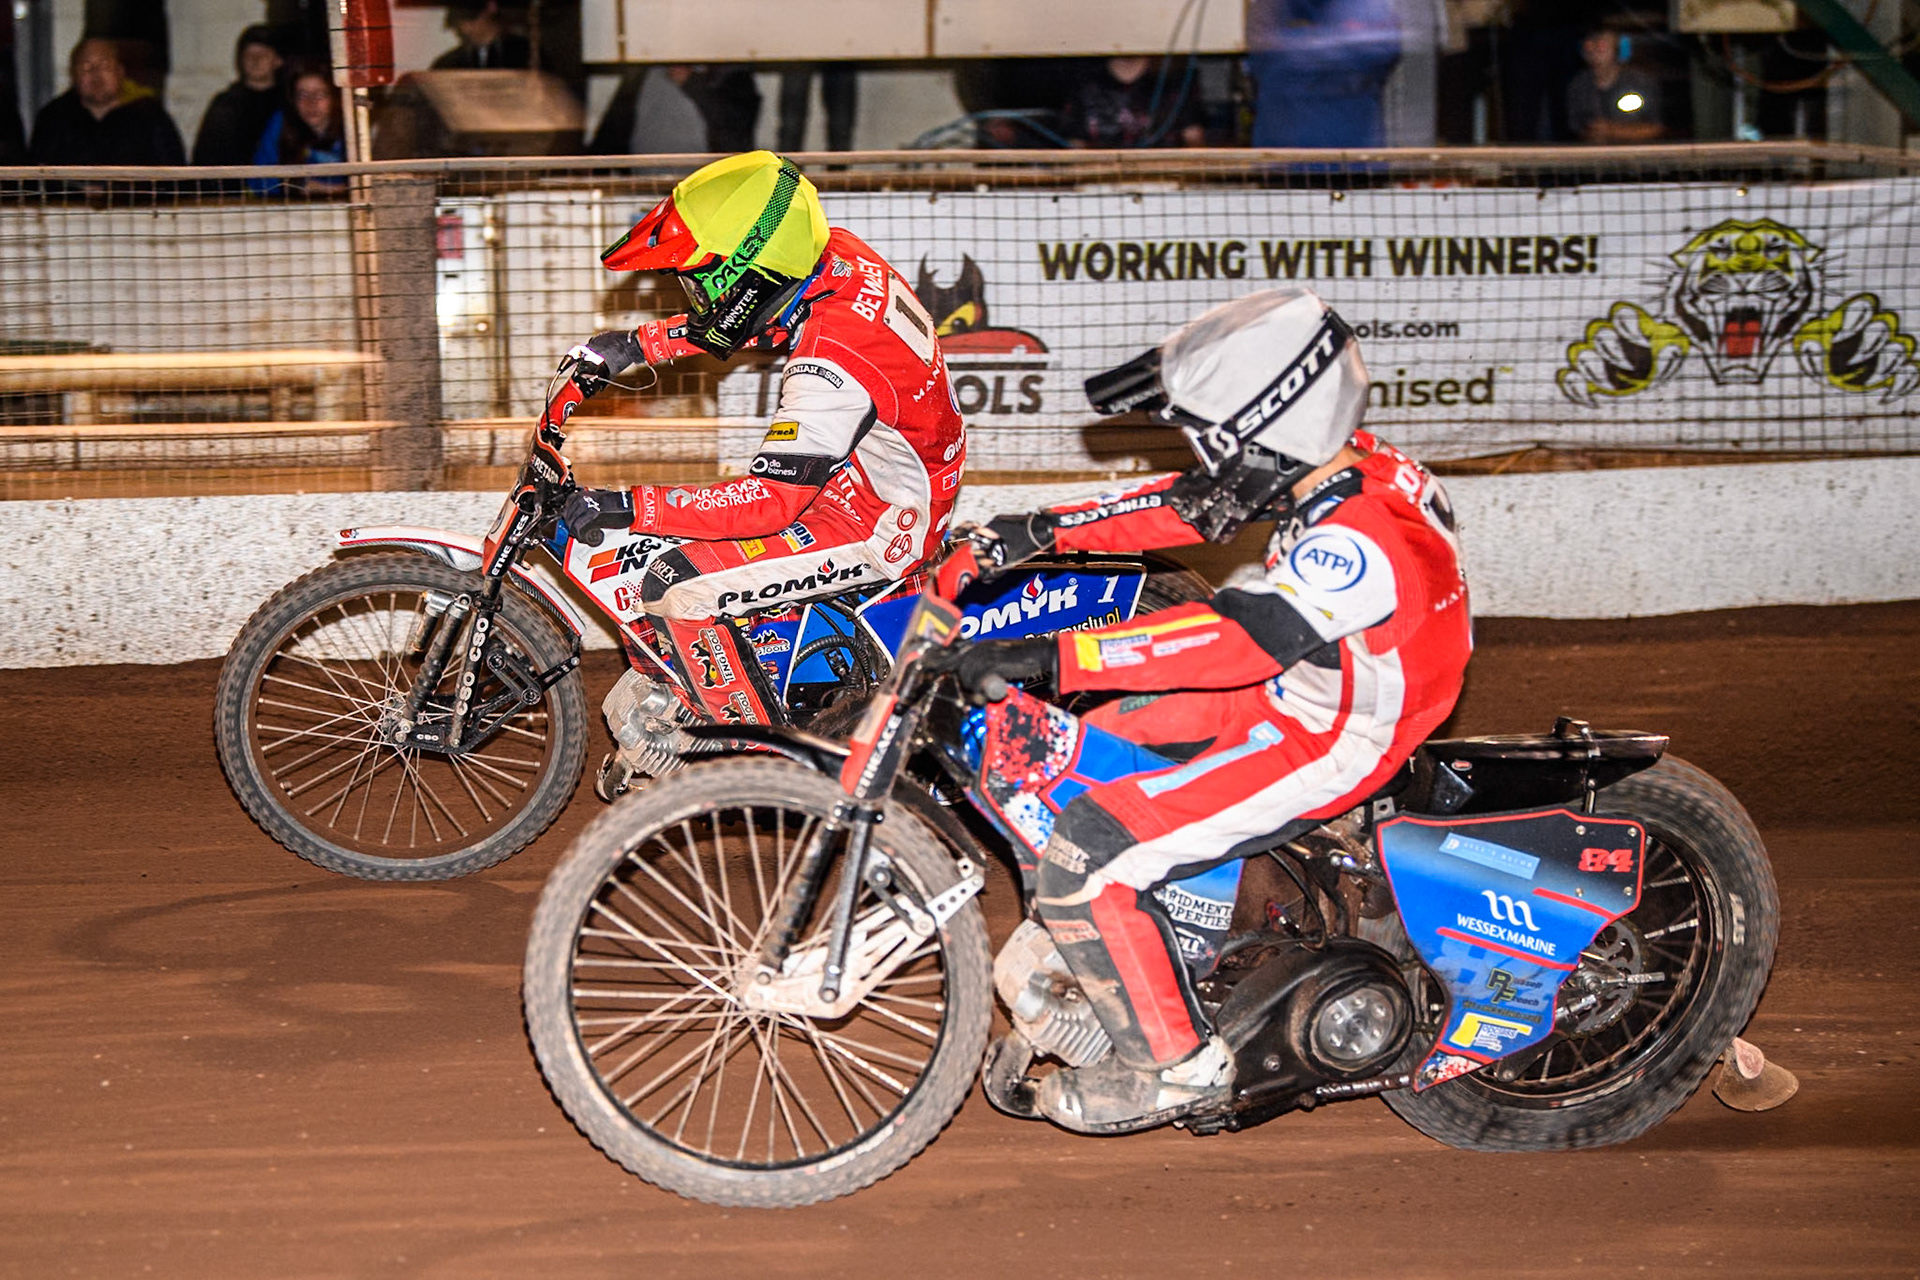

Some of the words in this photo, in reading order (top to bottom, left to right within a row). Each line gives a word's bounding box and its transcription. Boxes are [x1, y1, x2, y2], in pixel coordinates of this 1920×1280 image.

[712, 224, 765, 290] OAKLEY
[1039, 240, 1247, 281] WORKING
[1260, 239, 1374, 279] WITH
[1386, 235, 1599, 277] WINNERS!
[850, 255, 885, 323] BEWLEY
[719, 286, 759, 332] MONSTER
[733, 298, 759, 330] ENERGY
[1236, 327, 1337, 440] SCOTT
[768, 467, 796, 476] biznesu
[769, 459, 781, 468] dla
[1301, 547, 1355, 577] ATPI
[959, 582, 1080, 640] OMYK
[1097, 574, 1120, 604] 1
[1577, 847, 1634, 873] 84
[1505, 931, 1557, 957] MARINE
